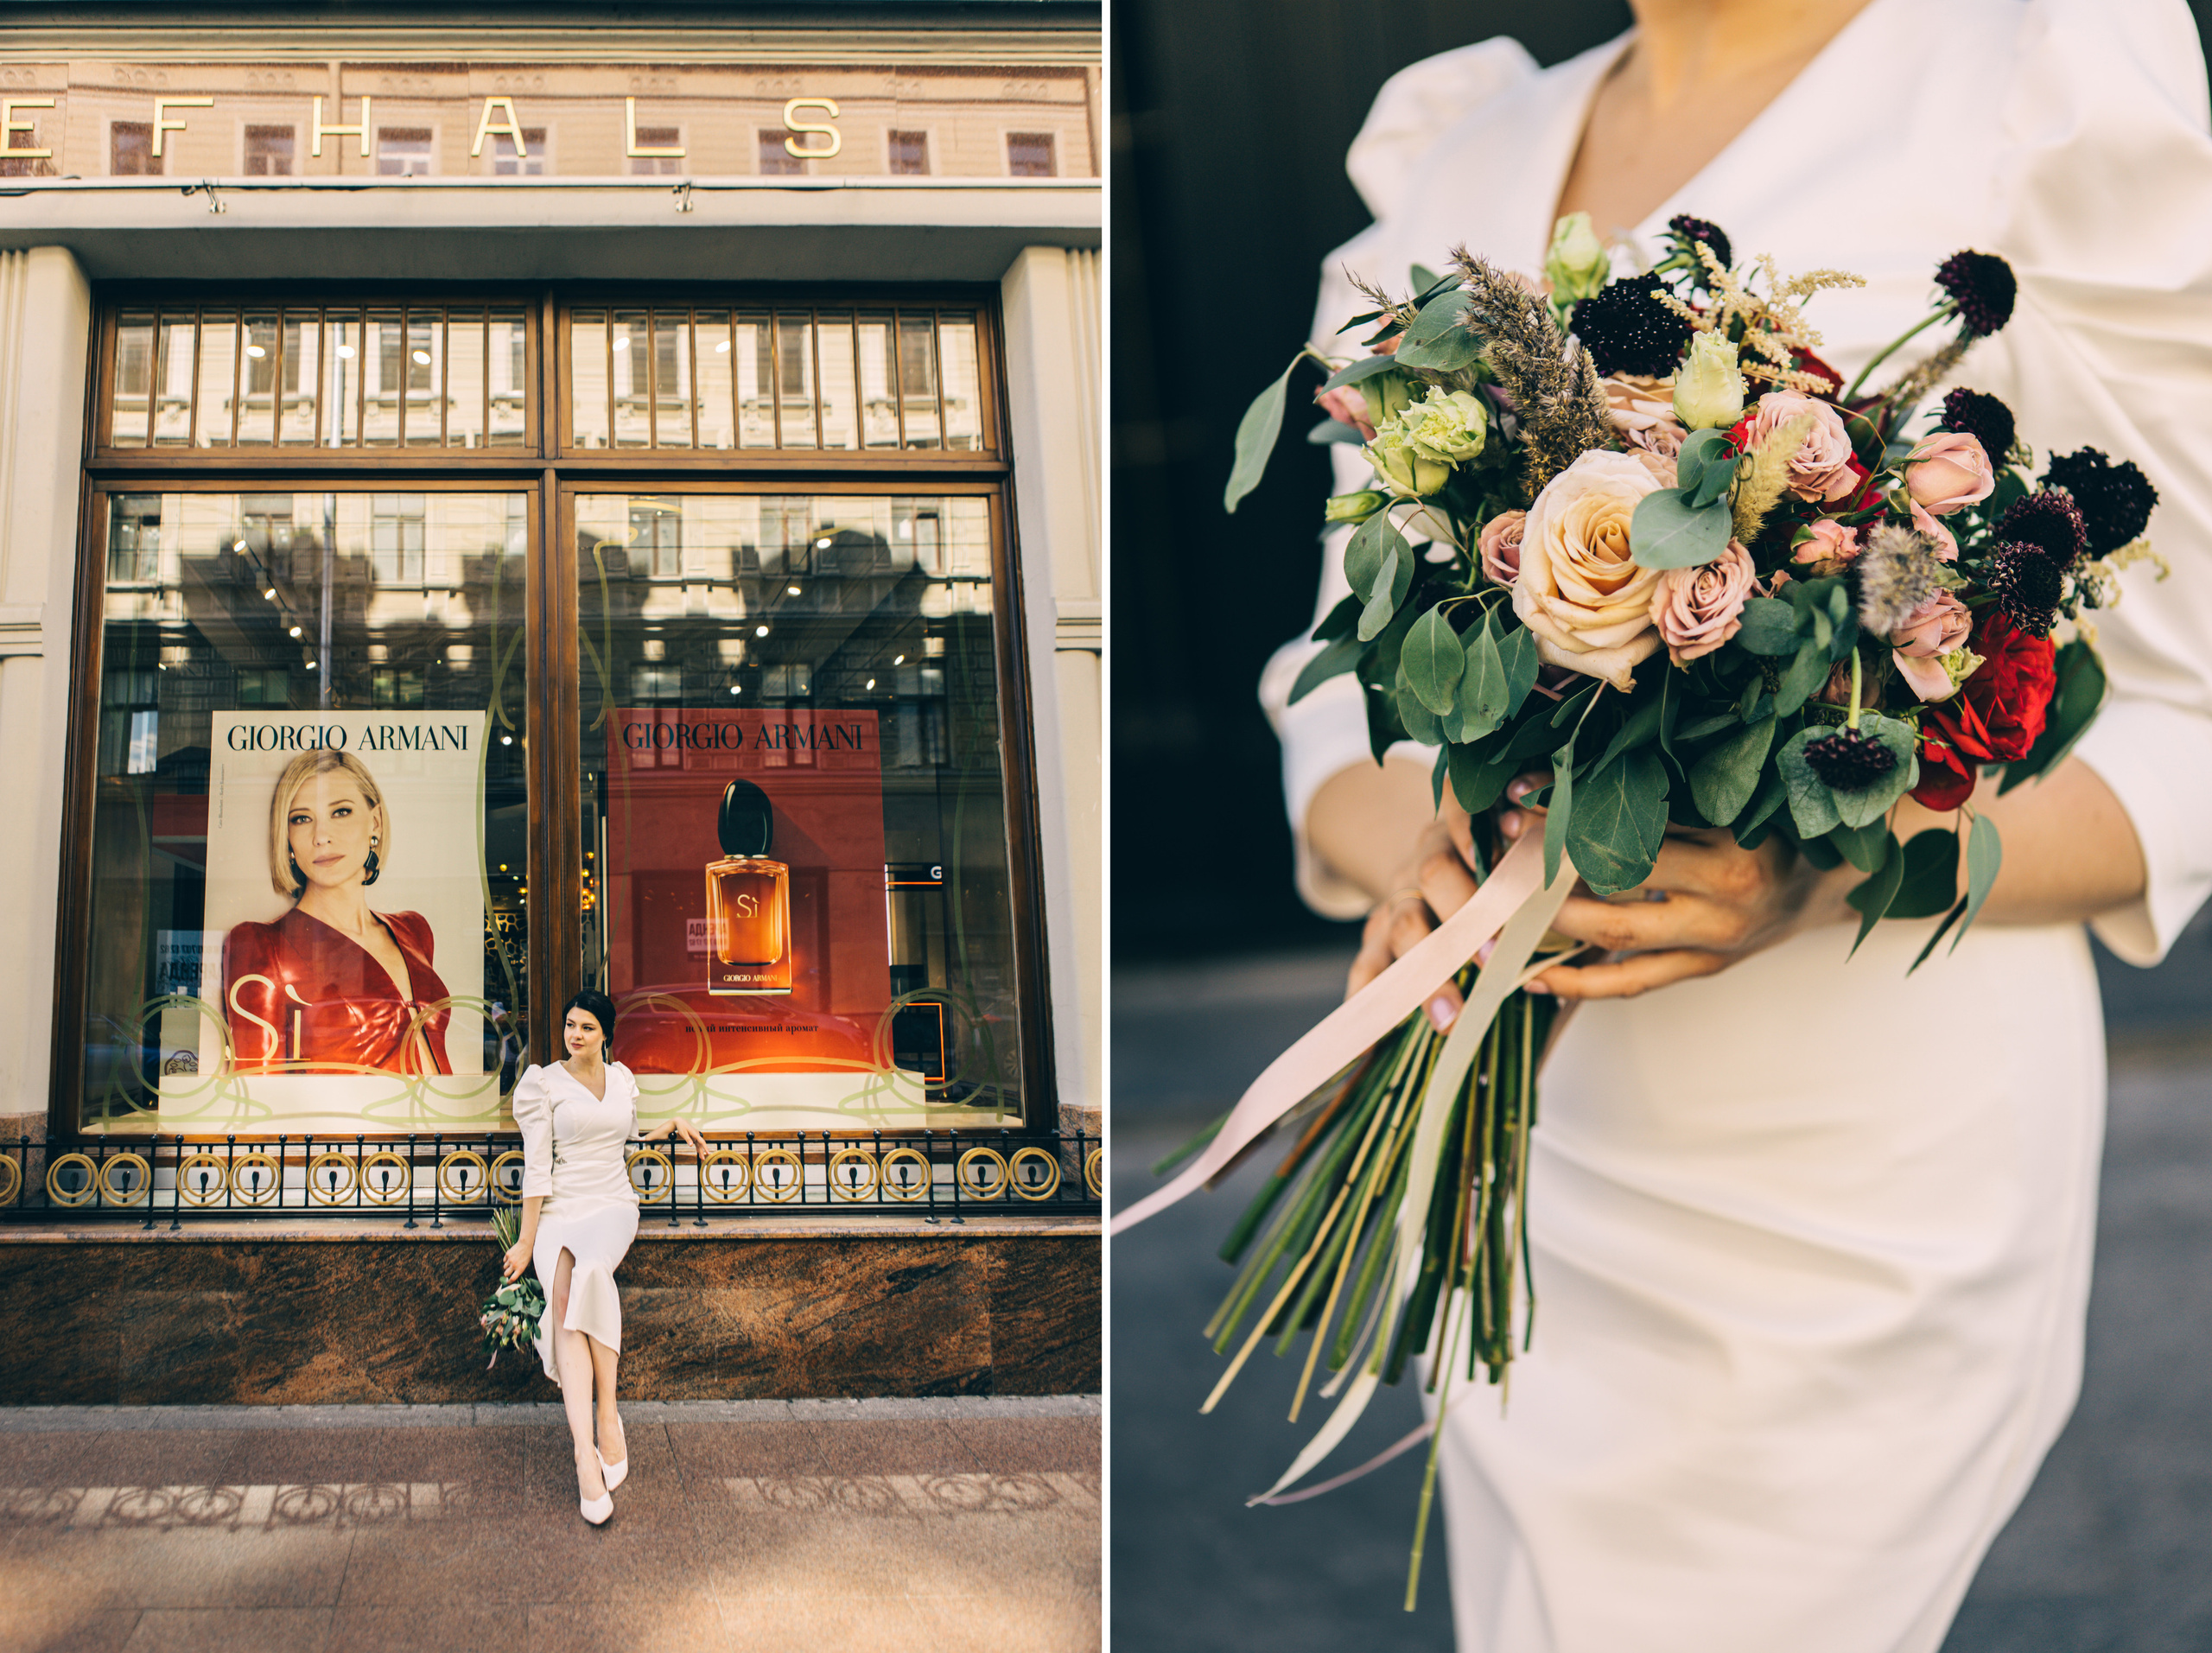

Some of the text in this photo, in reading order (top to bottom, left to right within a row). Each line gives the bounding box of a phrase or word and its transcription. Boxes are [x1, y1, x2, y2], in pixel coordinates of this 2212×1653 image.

[227, 724, 468, 751] GIORGIO ARMANI
[623, 722, 863, 750] GIORGIO ARMANI
[736, 894, 760, 918] Sì
[225, 974, 312, 1061] Sì
[719, 1024, 783, 1033] интенсивный
[785, 1025, 819, 1035] аромат
